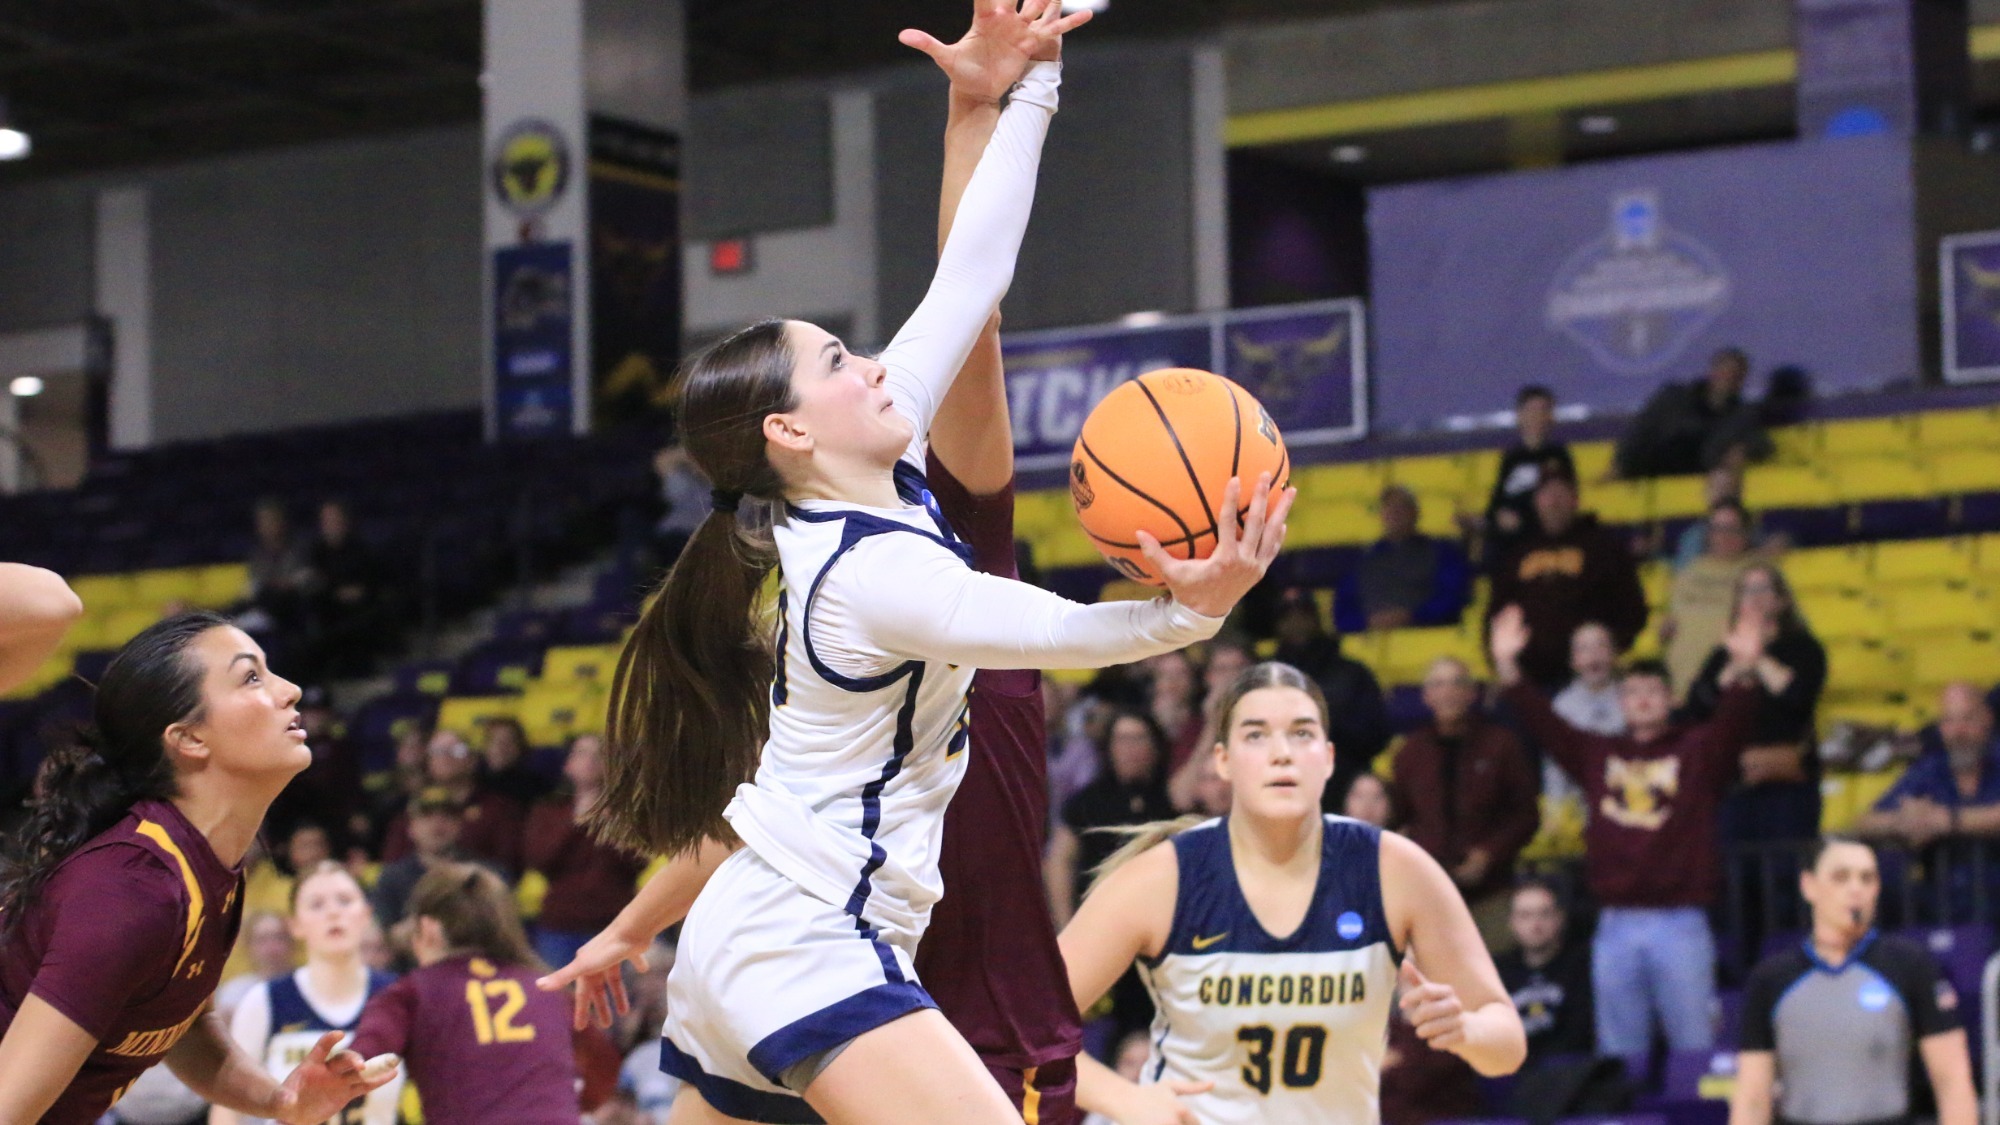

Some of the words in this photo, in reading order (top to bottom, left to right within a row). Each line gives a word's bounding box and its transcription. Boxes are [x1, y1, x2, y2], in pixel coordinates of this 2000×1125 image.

[466, 979, 535, 1044] 12
[1199, 972, 1366, 1006] CONCORDIA
[1236, 1023, 1328, 1096] 30
